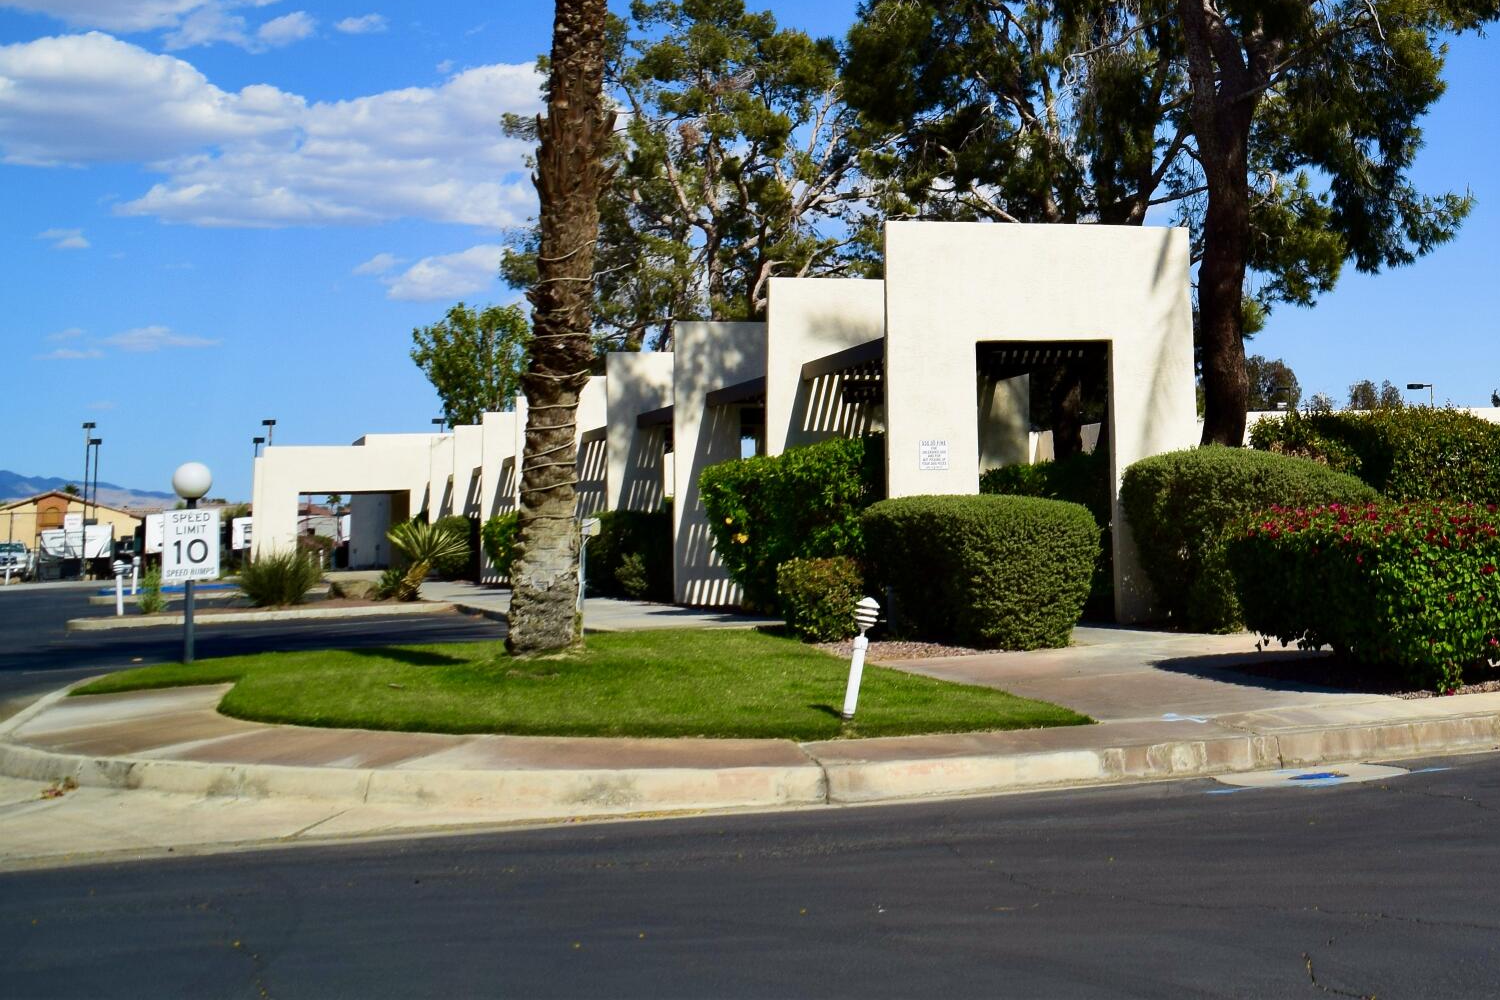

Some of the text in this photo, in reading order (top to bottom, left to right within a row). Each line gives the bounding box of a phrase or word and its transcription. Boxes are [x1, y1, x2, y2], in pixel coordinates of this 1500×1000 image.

[172, 512, 210, 523] SPEED
[176, 524, 206, 535] LIMIT
[173, 539, 208, 565] 10
[166, 569, 188, 578] SPEED
